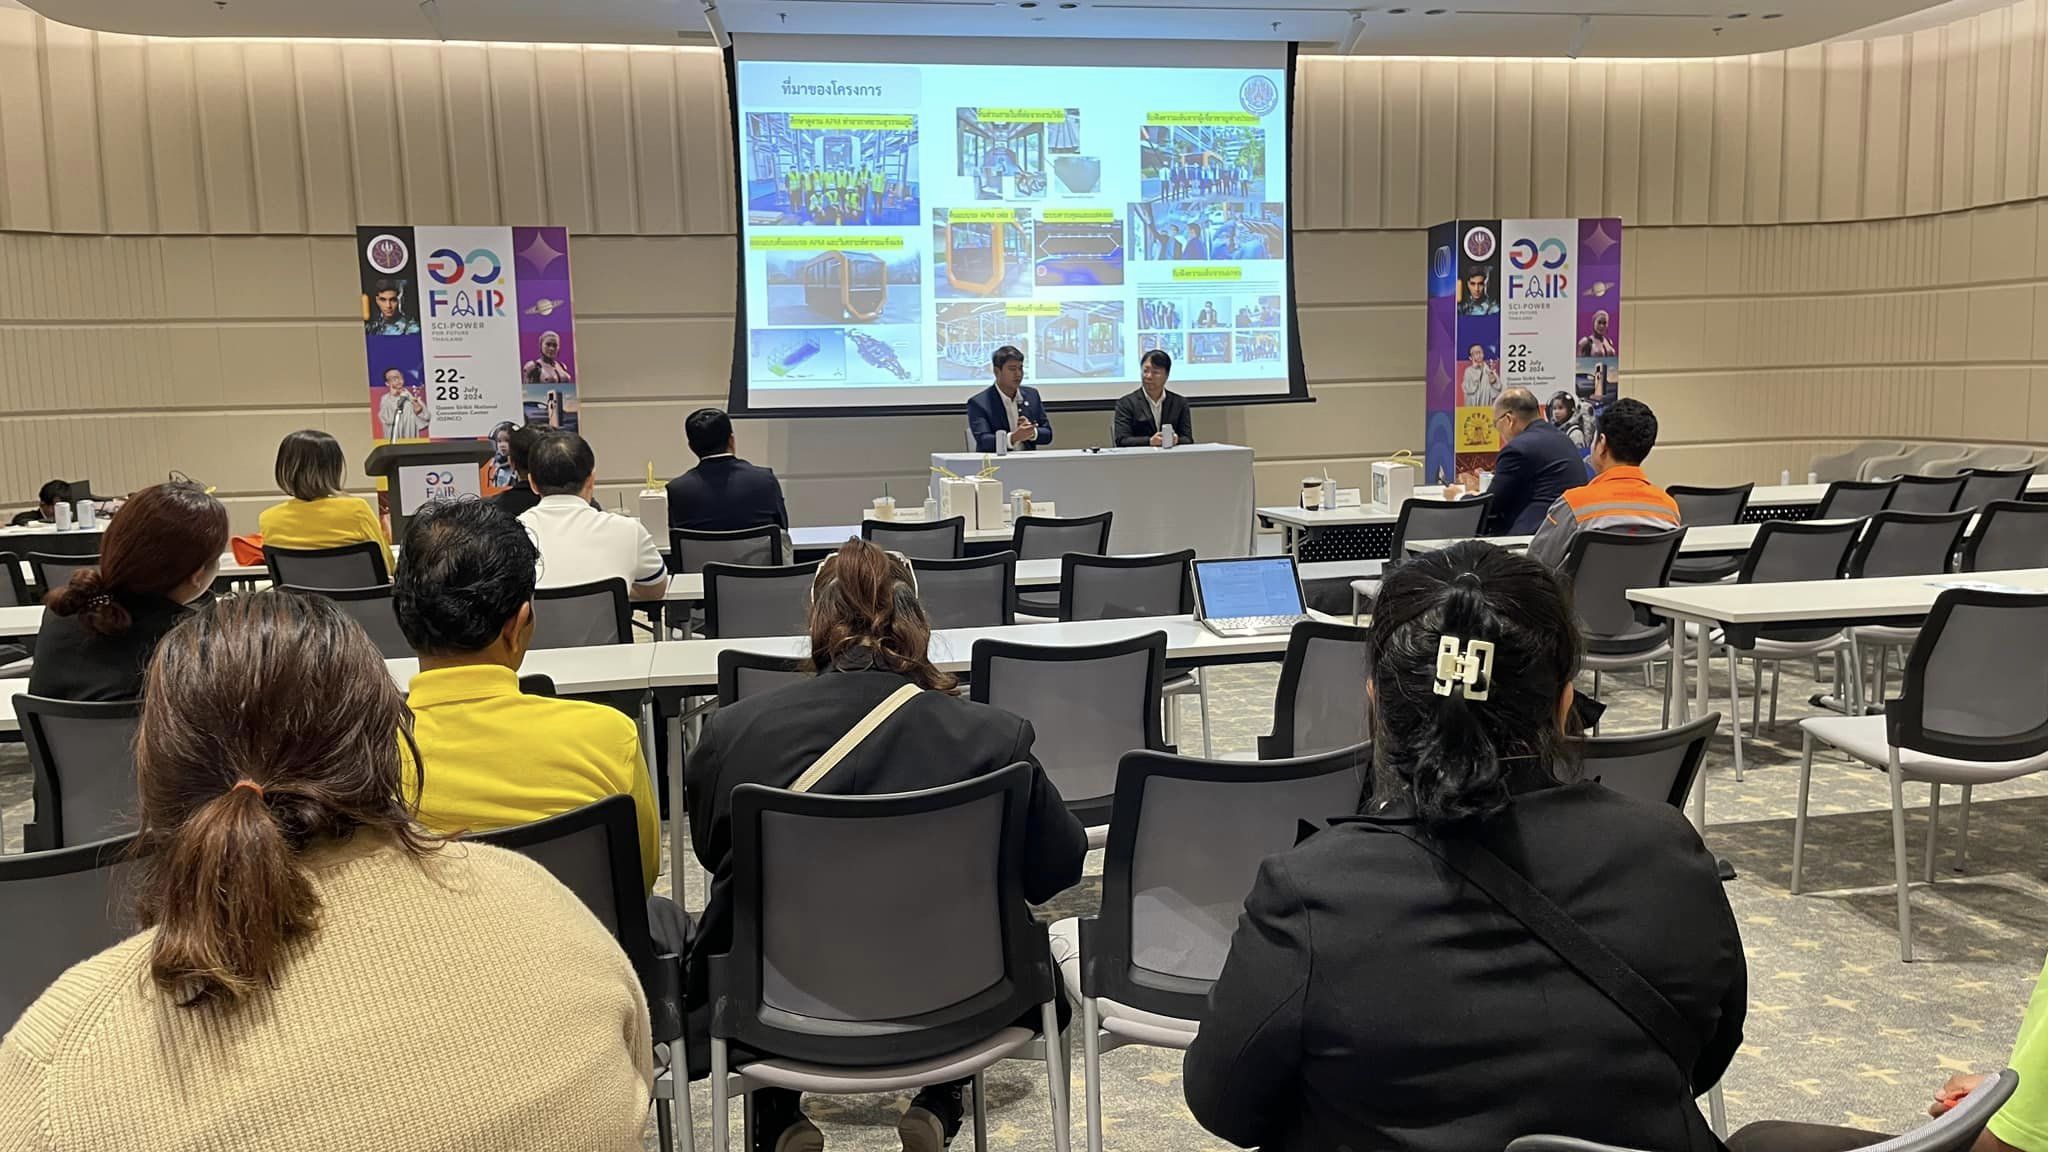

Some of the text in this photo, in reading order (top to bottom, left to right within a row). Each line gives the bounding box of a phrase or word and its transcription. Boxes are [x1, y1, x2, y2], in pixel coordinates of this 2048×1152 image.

[781, 76, 882, 97] ที่มาของโครงการ
[1508, 273, 1568, 299] FAIR
[429, 289, 506, 317] FAIR
[1507, 360, 1527, 373] 28
[436, 386, 460, 401] 28
